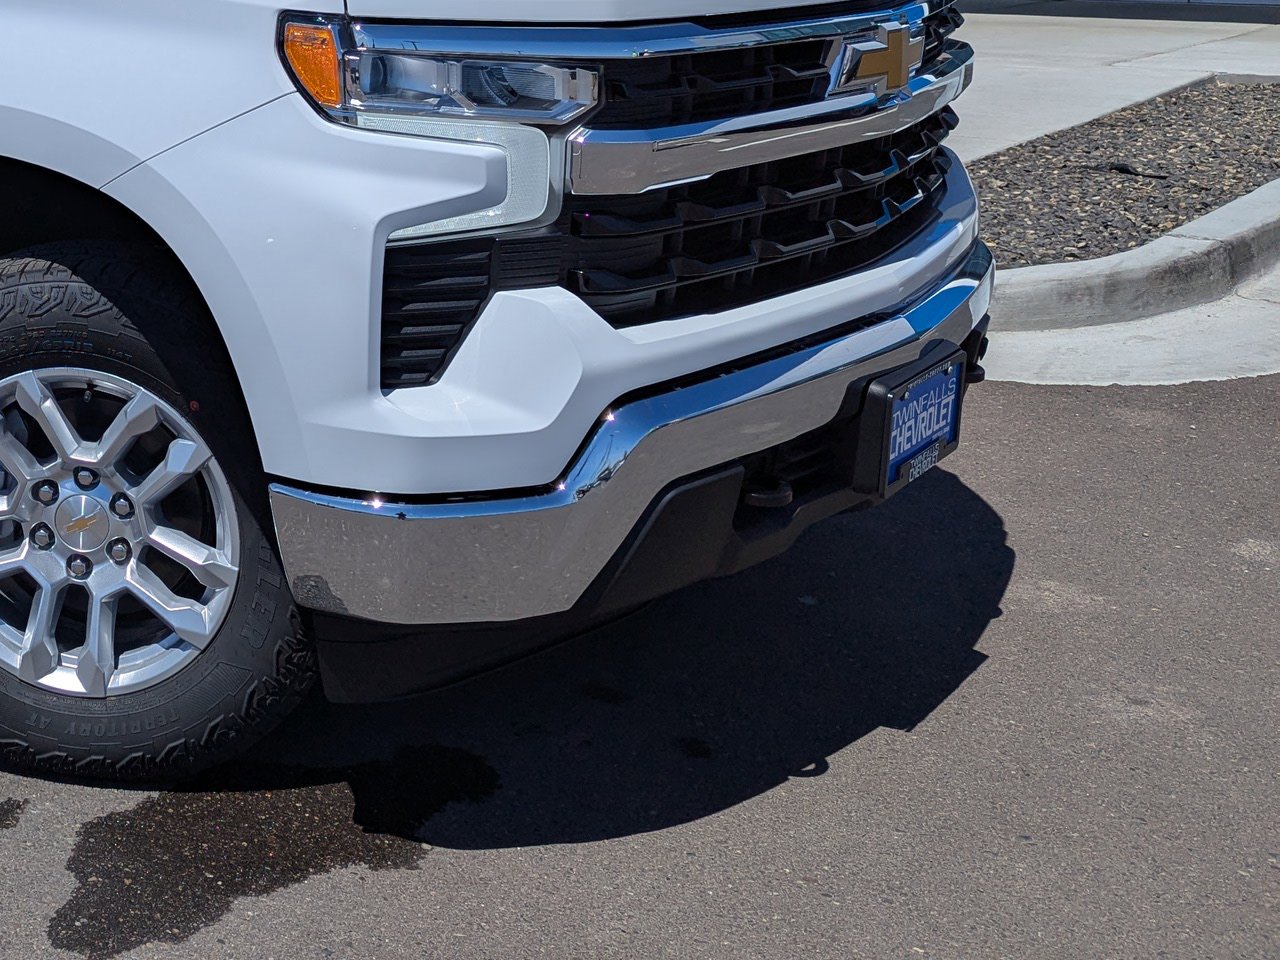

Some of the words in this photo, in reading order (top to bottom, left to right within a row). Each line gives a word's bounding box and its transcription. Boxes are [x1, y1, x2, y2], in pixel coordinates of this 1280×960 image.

[892, 377, 956, 429] TWINFALLS
[889, 394, 956, 460] CHEVROLET
[908, 452, 939, 483] CHEVROLET
[24, 711, 52, 729] AT
[64, 707, 181, 737] TERRITORY
